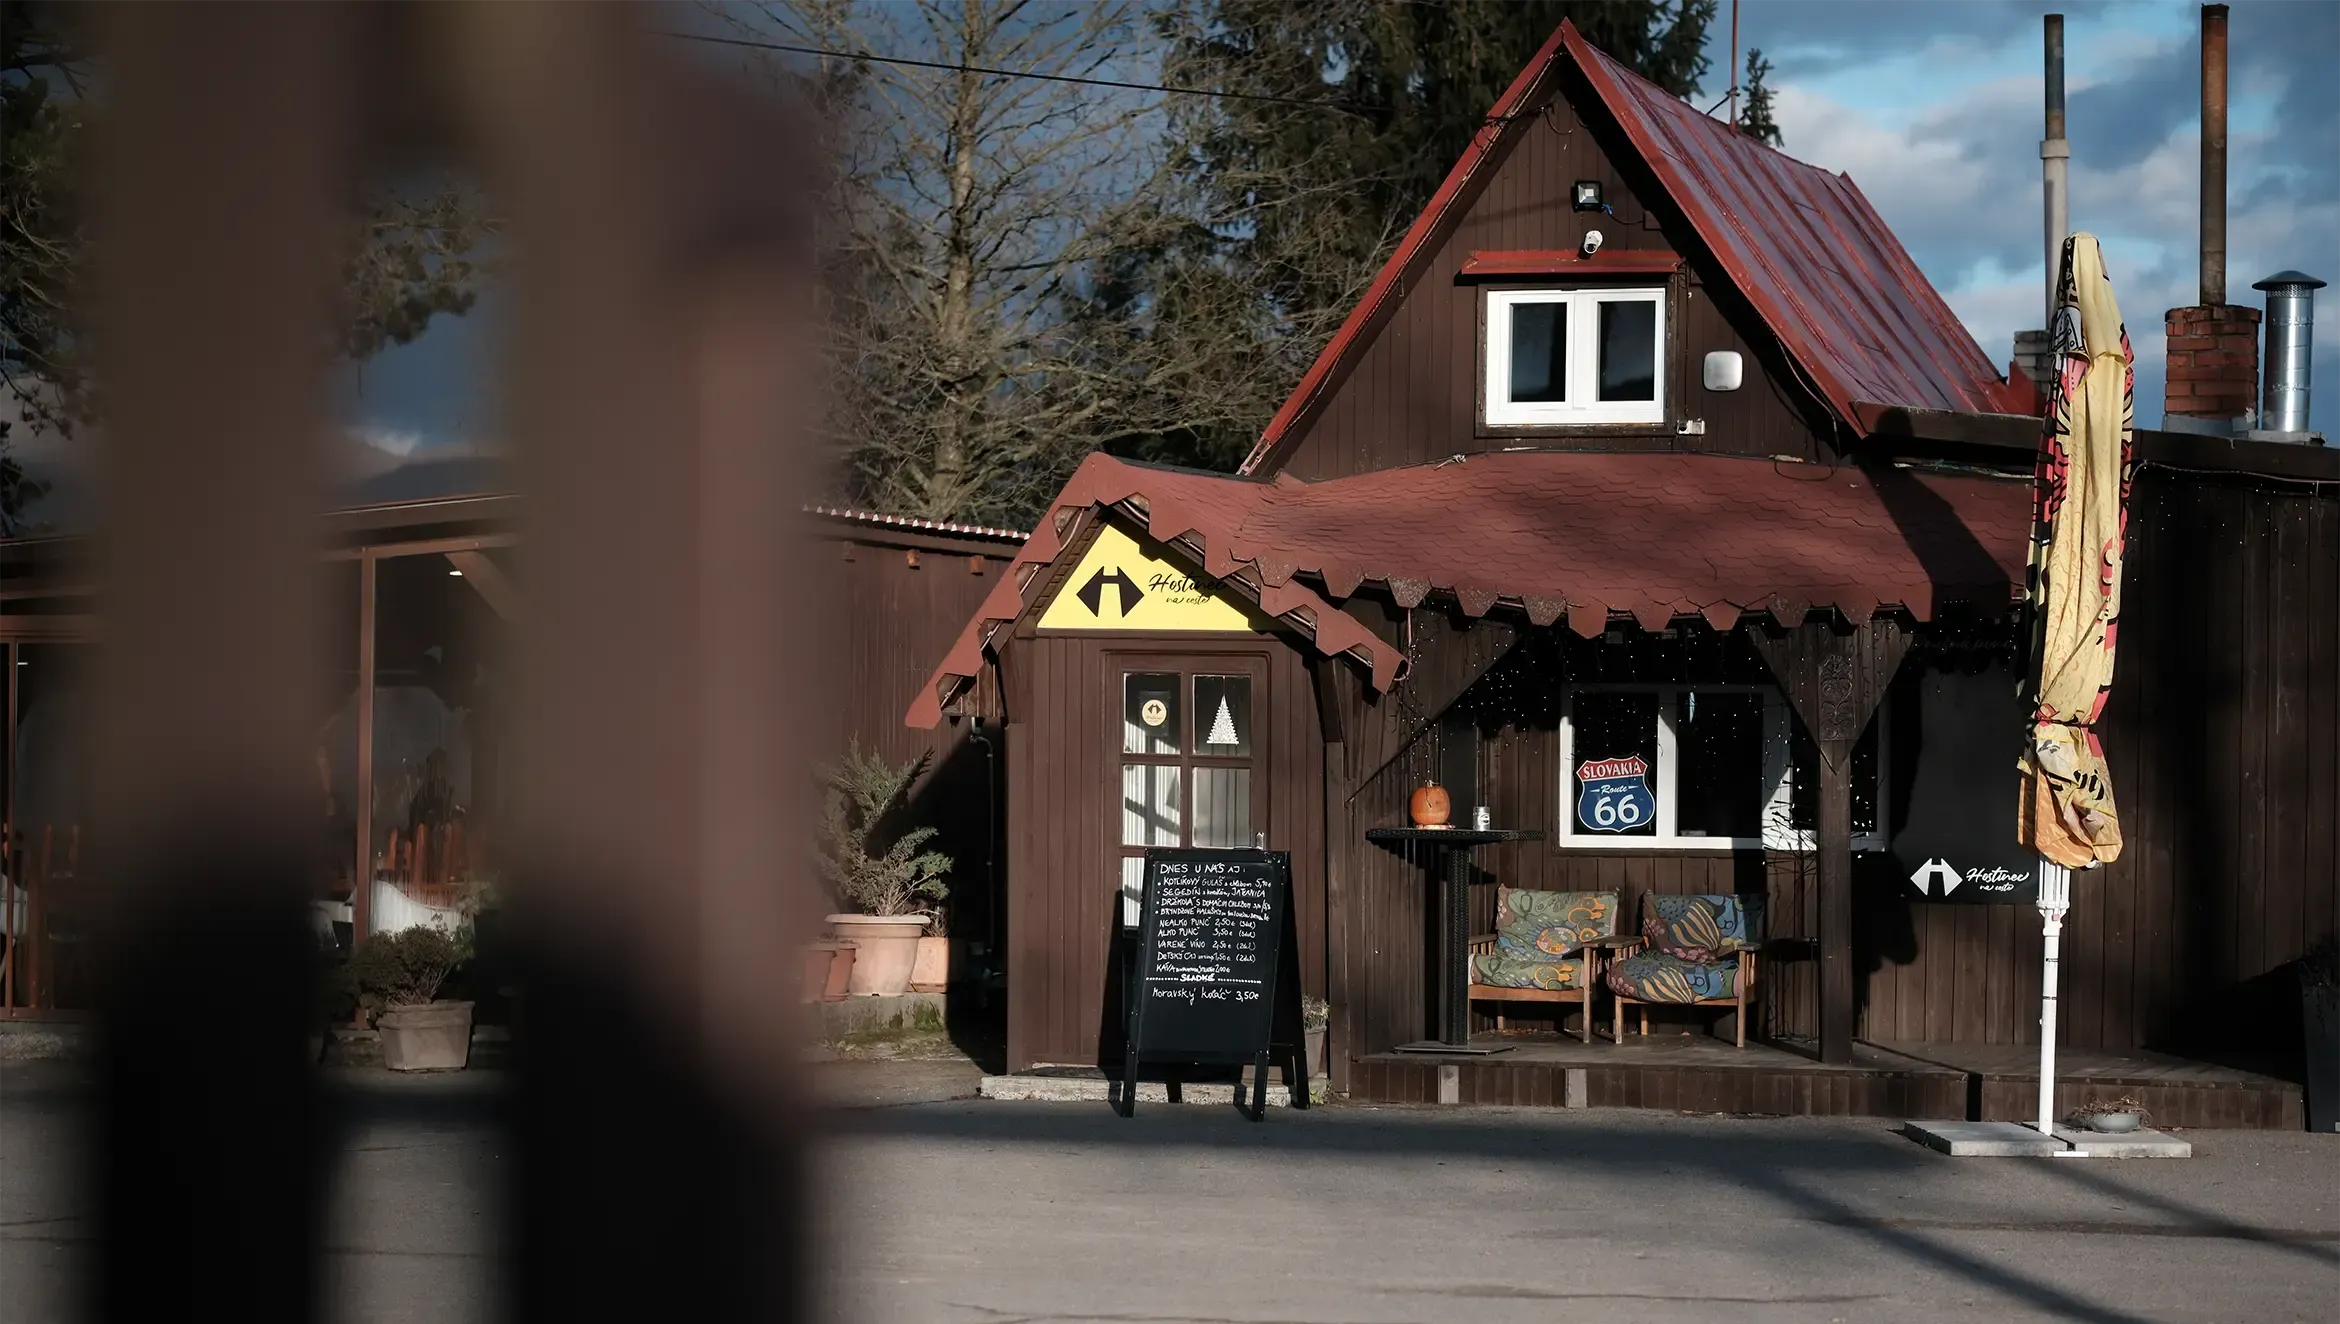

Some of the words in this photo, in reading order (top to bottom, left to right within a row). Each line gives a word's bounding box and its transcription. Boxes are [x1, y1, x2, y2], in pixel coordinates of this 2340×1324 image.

[1583, 761, 1641, 779] SLOVAKIA
[1600, 784, 1628, 795] Route
[1594, 794, 1640, 826] 66
[1160, 863, 1188, 874] DNES
[1195, 864, 1201, 873] U
[1966, 866, 2030, 883] Hostinec
[1162, 887, 1201, 896] SEGEDÍN
[1159, 919, 1188, 928] NEALKO
[1191, 917, 1211, 927] PUNČ
[1158, 929, 1176, 937] ALKO
[1157, 938, 1189, 948] VARENÉ
[1190, 939, 1206, 948] VÍNO
[1180, 973, 1215, 981] SLADKÉ
[1152, 987, 1196, 1005] Moravský
[1236, 991, 1260, 1002] 3,50€
